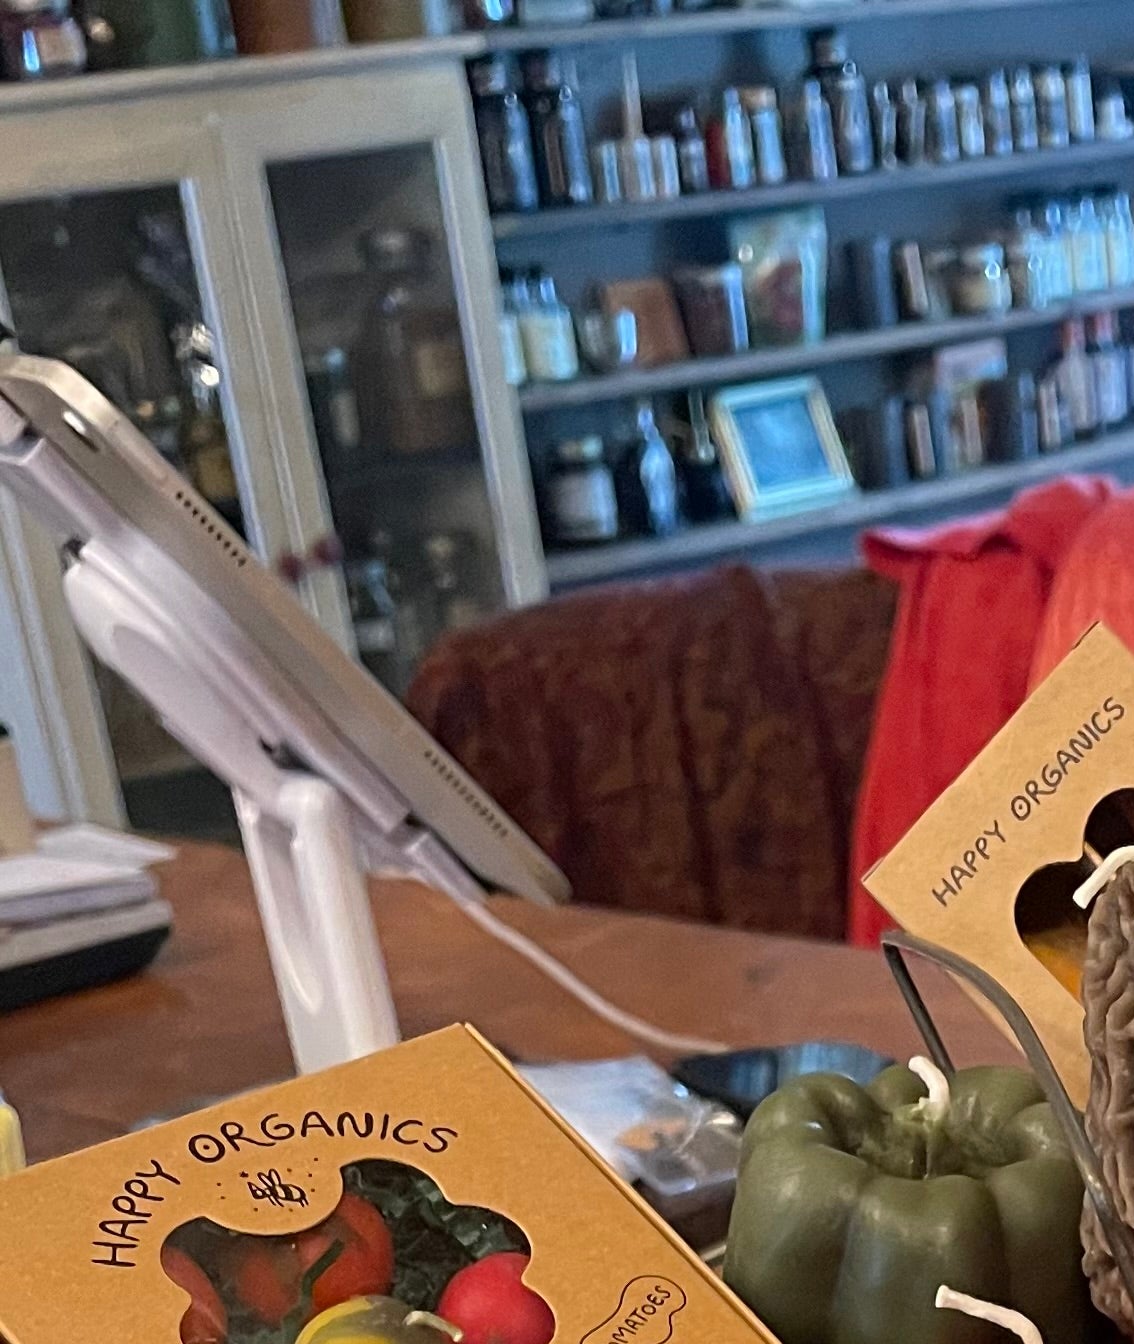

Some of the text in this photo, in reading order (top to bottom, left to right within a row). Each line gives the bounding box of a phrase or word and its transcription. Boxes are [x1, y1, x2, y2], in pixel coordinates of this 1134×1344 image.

[931, 695, 1126, 908] HAPPY ORGANICS
[91, 1111, 459, 1268] HAPPY ORGANICS
